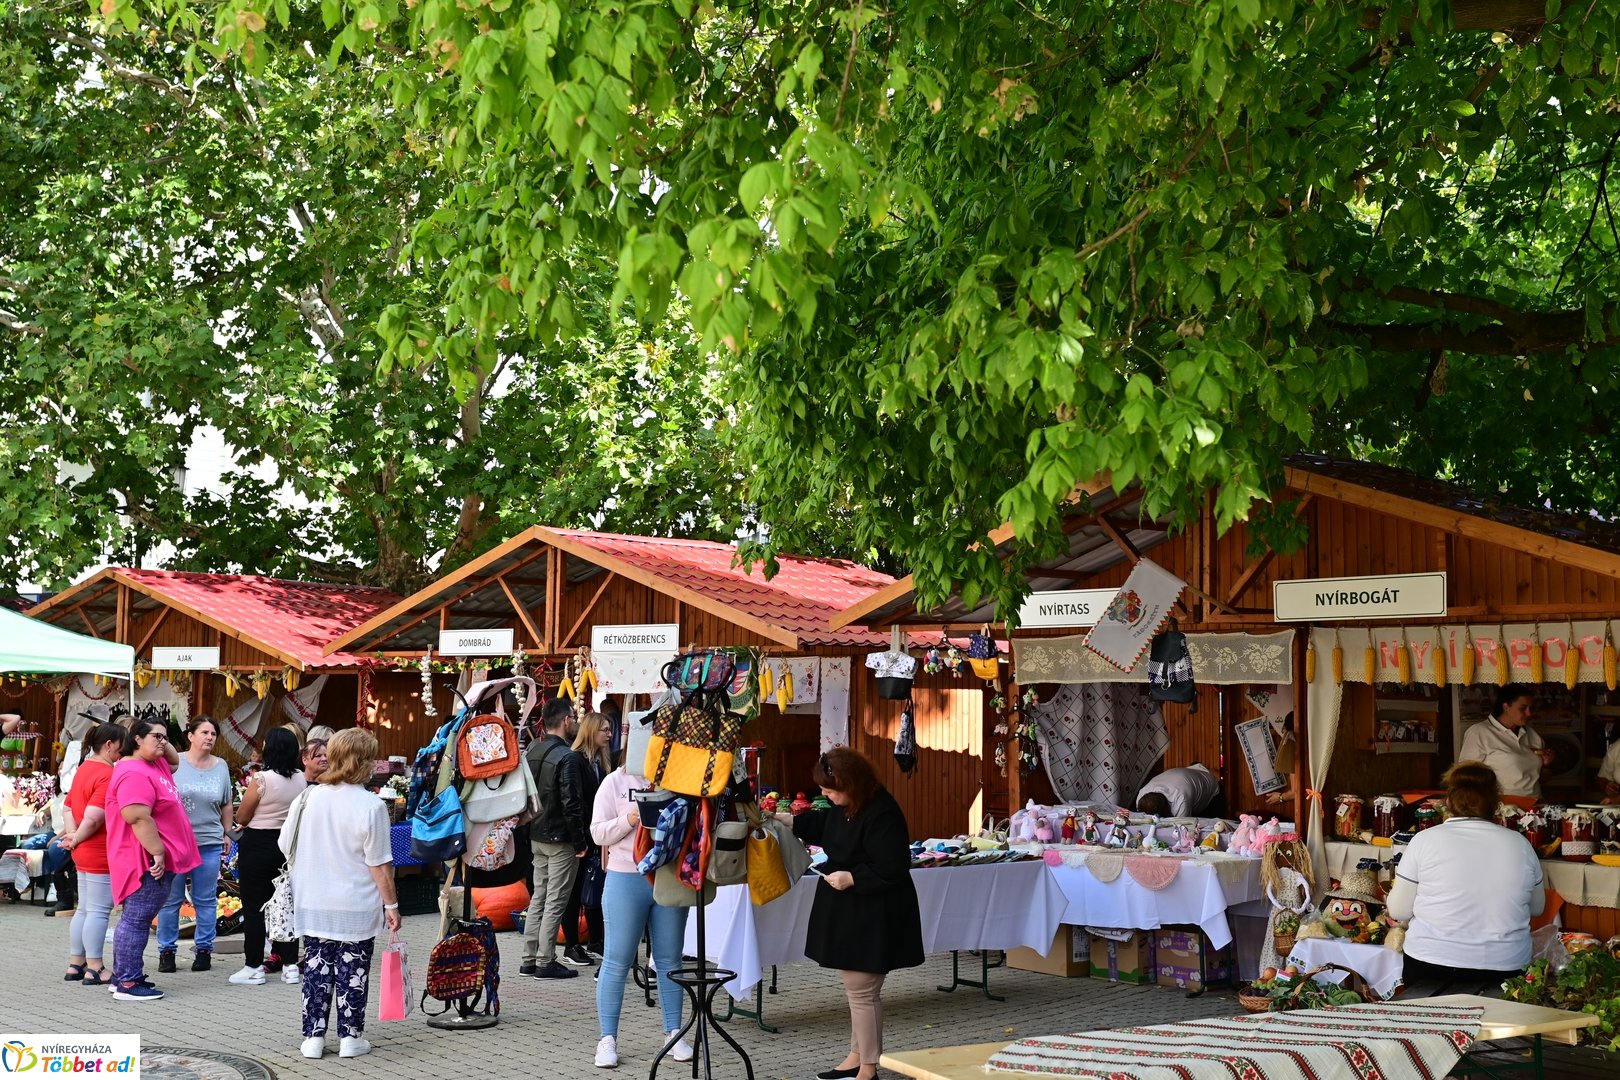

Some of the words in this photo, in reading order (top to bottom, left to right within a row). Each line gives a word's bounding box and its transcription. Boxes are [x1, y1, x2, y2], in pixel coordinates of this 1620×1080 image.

[1315, 588, 1399, 606] NYÍRBOGÁT
[1039, 603, 1090, 616] NYÍRTASS
[458, 637, 492, 647] DOMBRÁD
[603, 634, 666, 644] RÉTKÖZBERENCS
[1380, 630, 1620, 669] NYÍRBOG
[177, 654, 192, 662] AJAK
[182, 783, 219, 793] Dance
